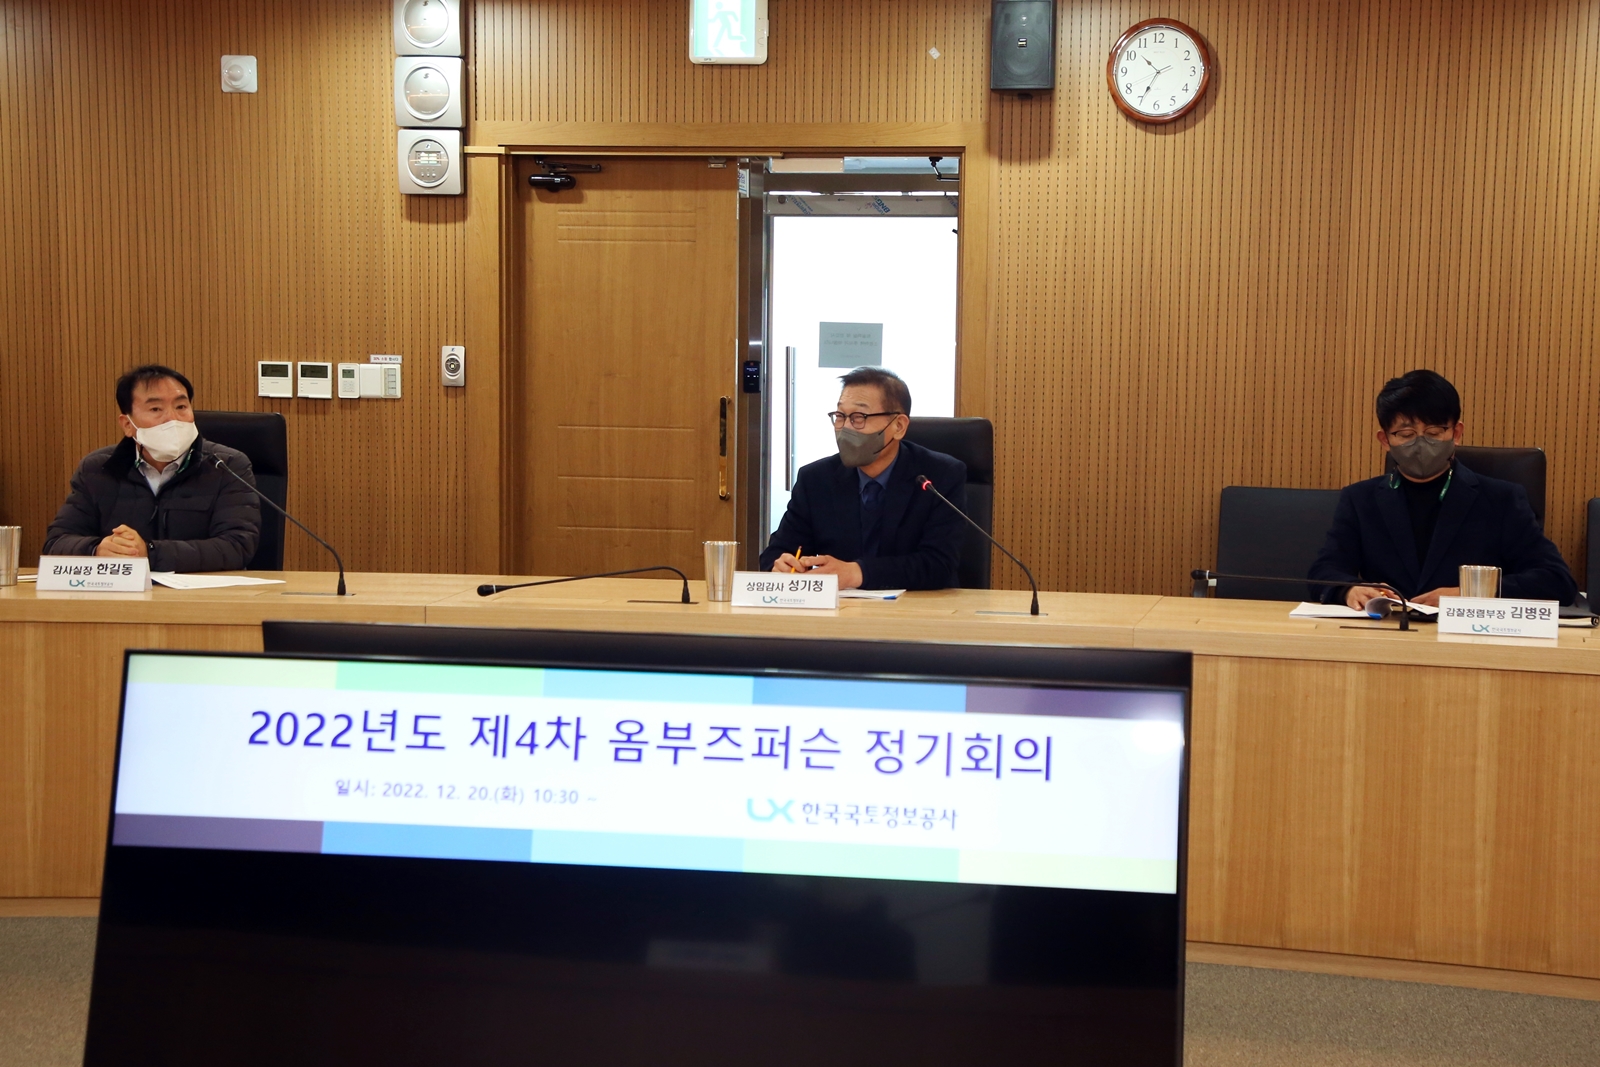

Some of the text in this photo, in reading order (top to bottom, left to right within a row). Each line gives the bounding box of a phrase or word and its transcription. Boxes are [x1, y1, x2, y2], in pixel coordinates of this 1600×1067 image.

[1138, 38, 1148, 49] 11
[1153, 32, 1165, 44] 12
[1174, 38, 1179, 49] 1
[1126, 50, 1137, 61] 10
[1183, 50, 1191, 61] 2
[1121, 66, 1128, 77] 9
[1189, 66, 1196, 77] 3
[1125, 83, 1133, 94] 8
[1181, 83, 1189, 93] 4
[1137, 95, 1144, 107] 7
[1153, 100, 1160, 111] 6
[1169, 95, 1176, 107] 5
[53, 563, 133, 576] 감사실장 한길동
[746, 579, 824, 592] 상임감사 성기청
[1446, 606, 1552, 620] 감찰청렴부장 김병완
[247, 709, 1054, 782] 2022년도 제4차 옴부즈퍼슨 정기회의
[335, 778, 376, 799] 일시:
[382, 782, 428, 800] 2022.
[437, 784, 461, 801] 12.
[533, 787, 579, 805] 10:30
[801, 801, 960, 832] 한국국토정보공사
